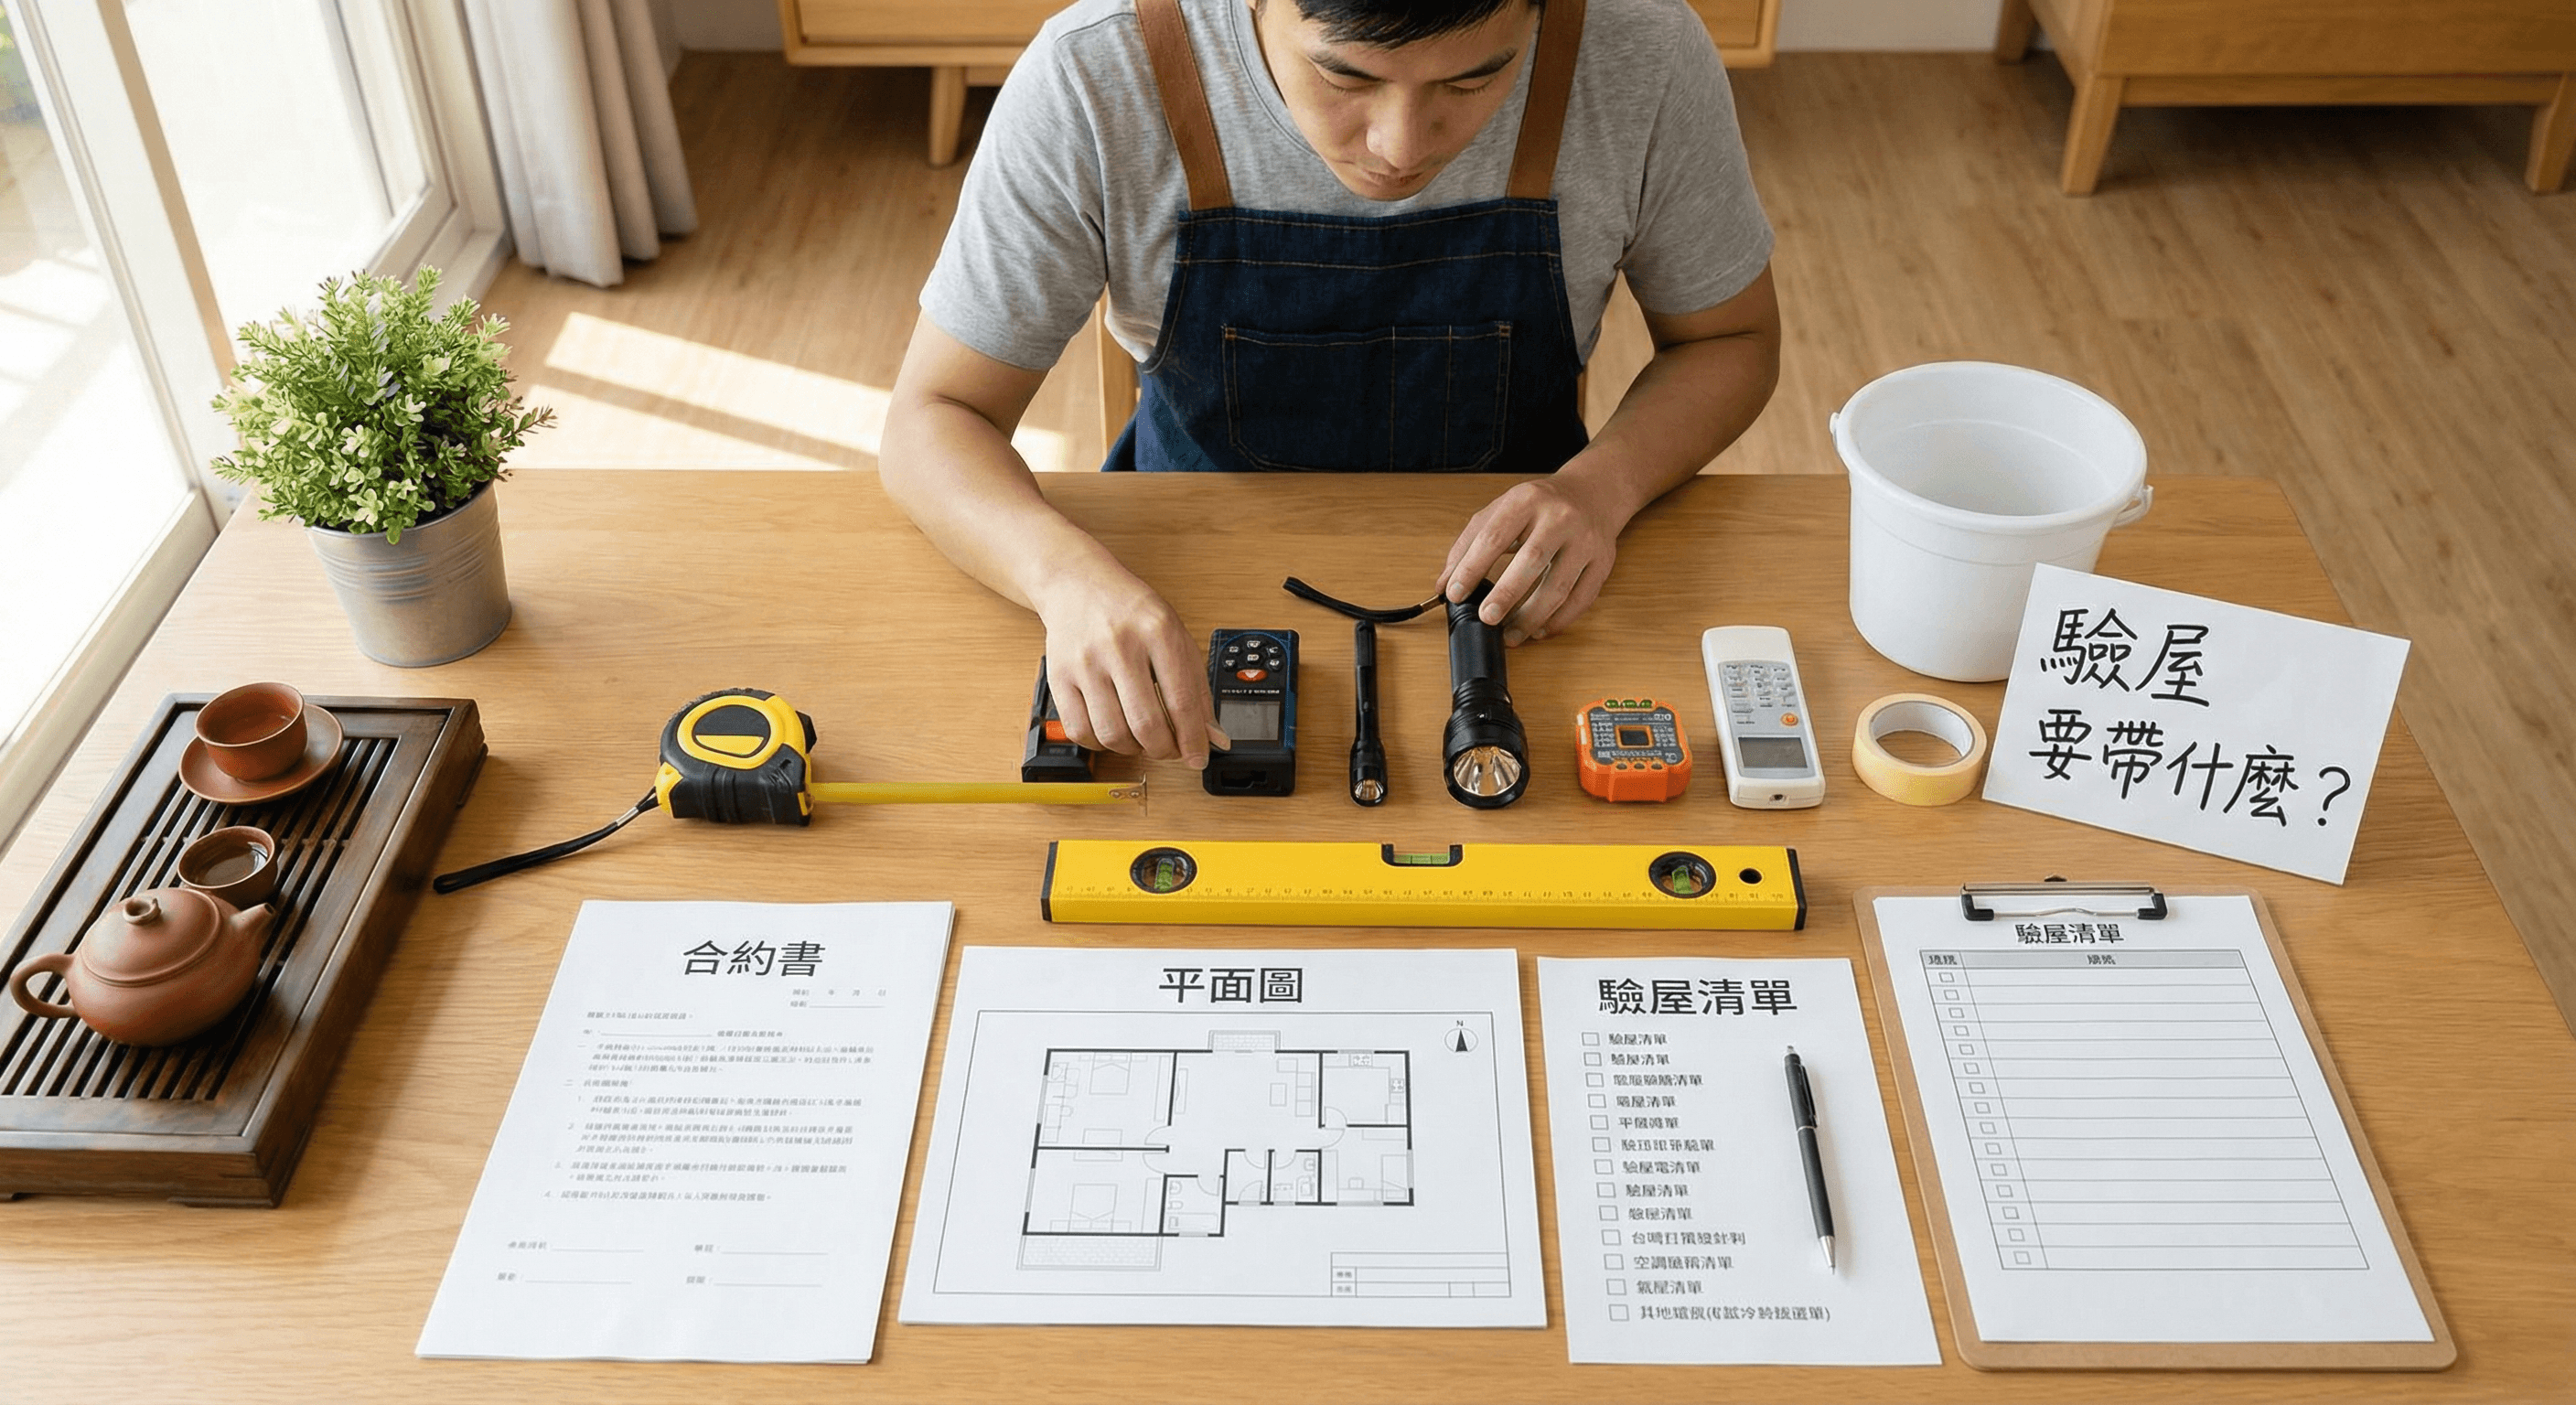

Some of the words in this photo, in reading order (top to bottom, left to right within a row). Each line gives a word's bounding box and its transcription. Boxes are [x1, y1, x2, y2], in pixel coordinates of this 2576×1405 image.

[2039, 607, 2210, 708] 驗屋
[2028, 708, 2352, 828] 要帶什麼？
[2014, 922, 2125, 945] 驗屋清單
[682, 939, 826, 977] 合約書
[1158, 967, 1304, 1004] 平面圖
[1597, 977, 1798, 1016] 驗屋清單
